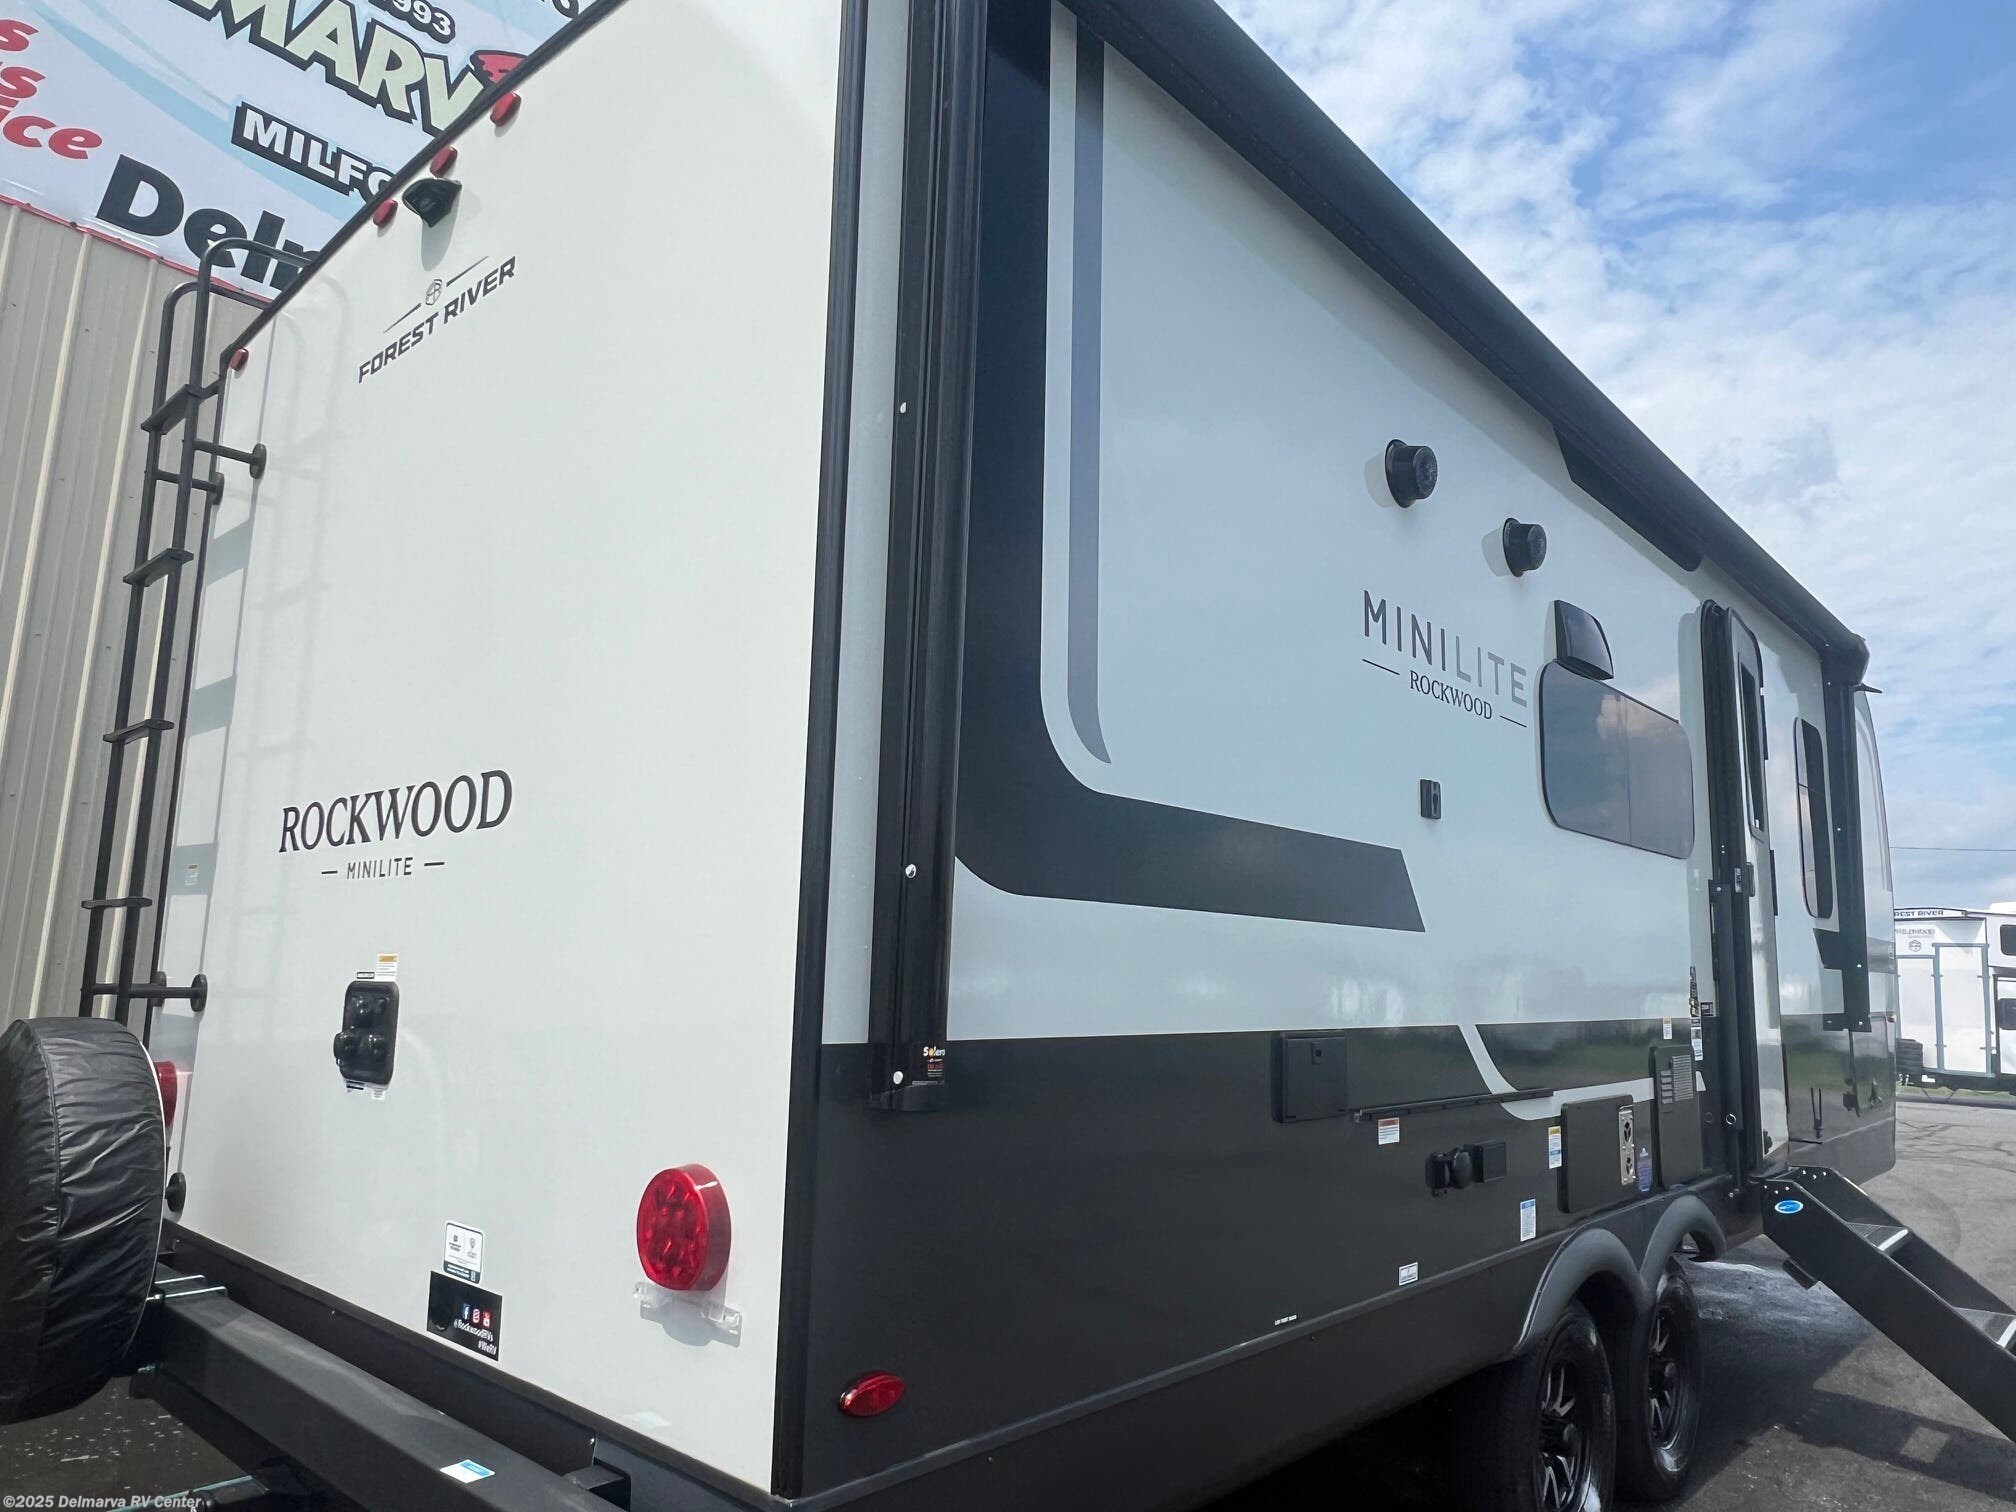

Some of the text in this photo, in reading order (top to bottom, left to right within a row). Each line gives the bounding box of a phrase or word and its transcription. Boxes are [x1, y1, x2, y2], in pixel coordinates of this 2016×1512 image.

[358, 255, 516, 384] FOREST RIVER
[1363, 589, 1528, 708] MINILITE
[1410, 669, 1493, 720] ROCKWOOD
[278, 769, 513, 853] ROCKWOOD
[346, 857, 414, 880] MINILITE
